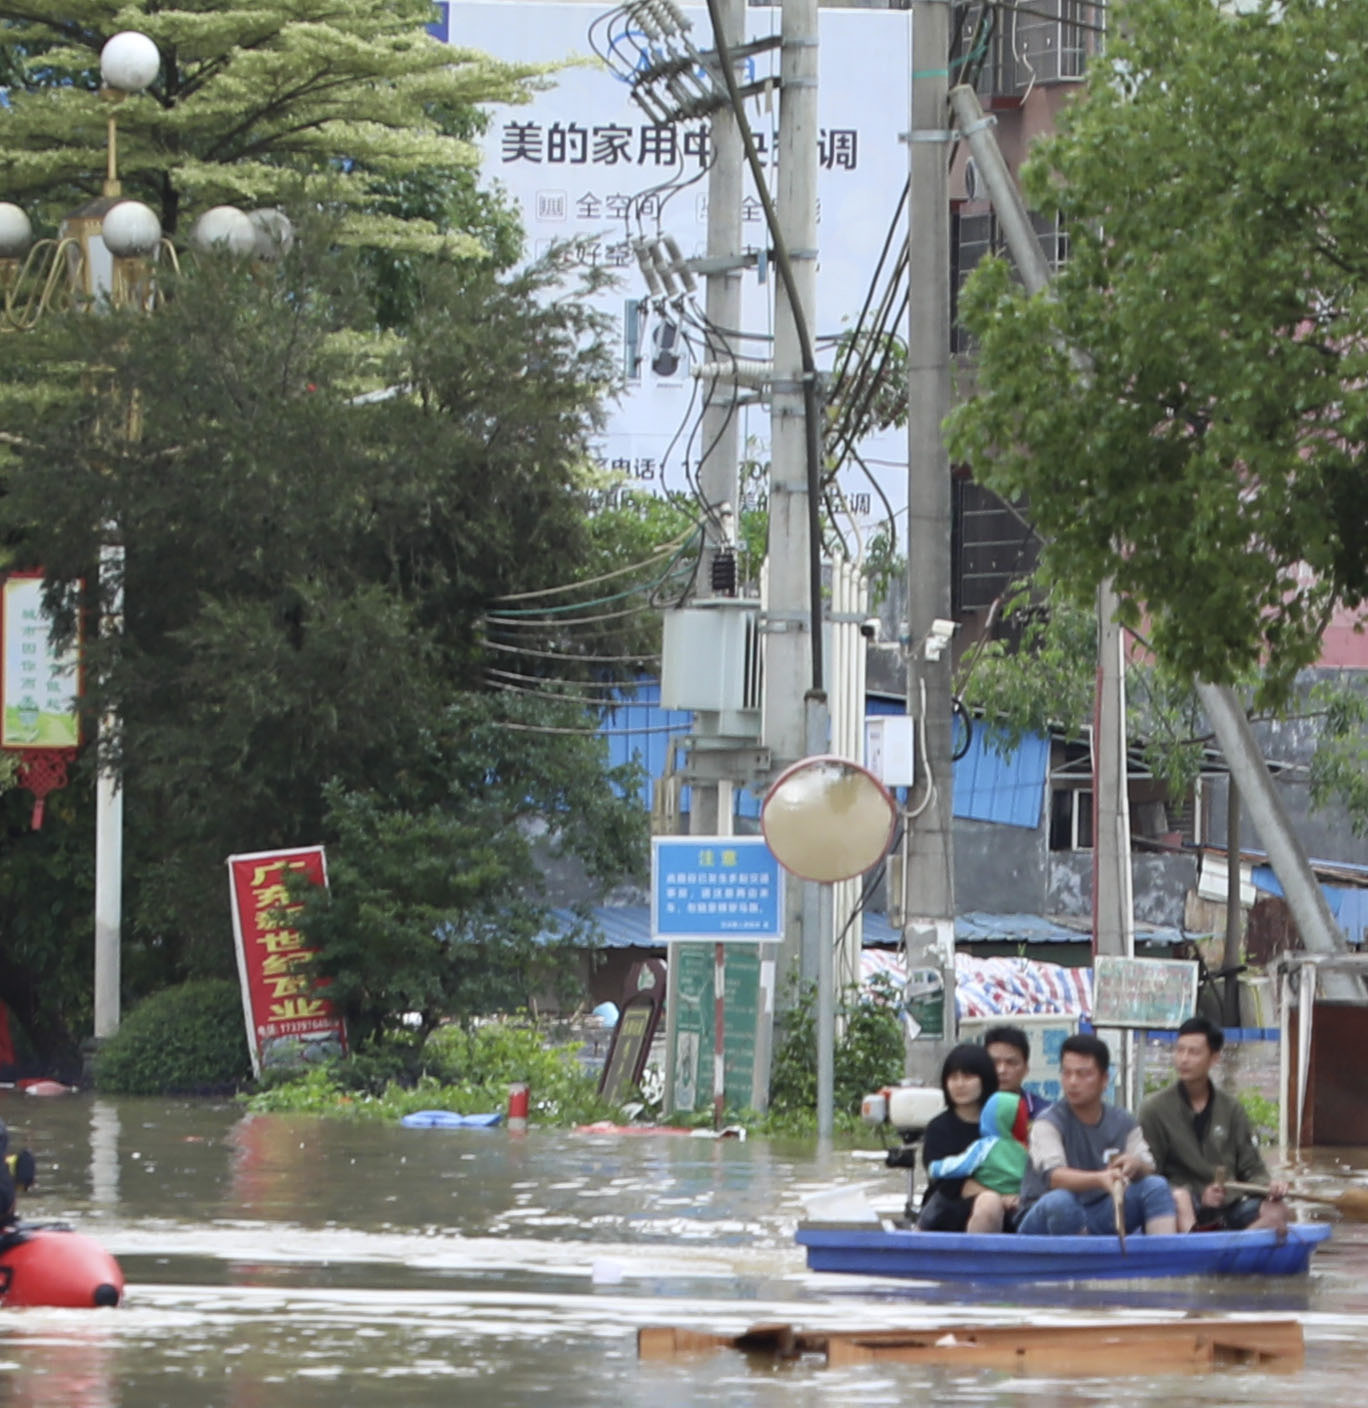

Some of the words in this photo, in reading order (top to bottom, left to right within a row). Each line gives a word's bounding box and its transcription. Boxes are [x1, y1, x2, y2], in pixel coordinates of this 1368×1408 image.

[502, 122, 858, 170] 美的家用中调
